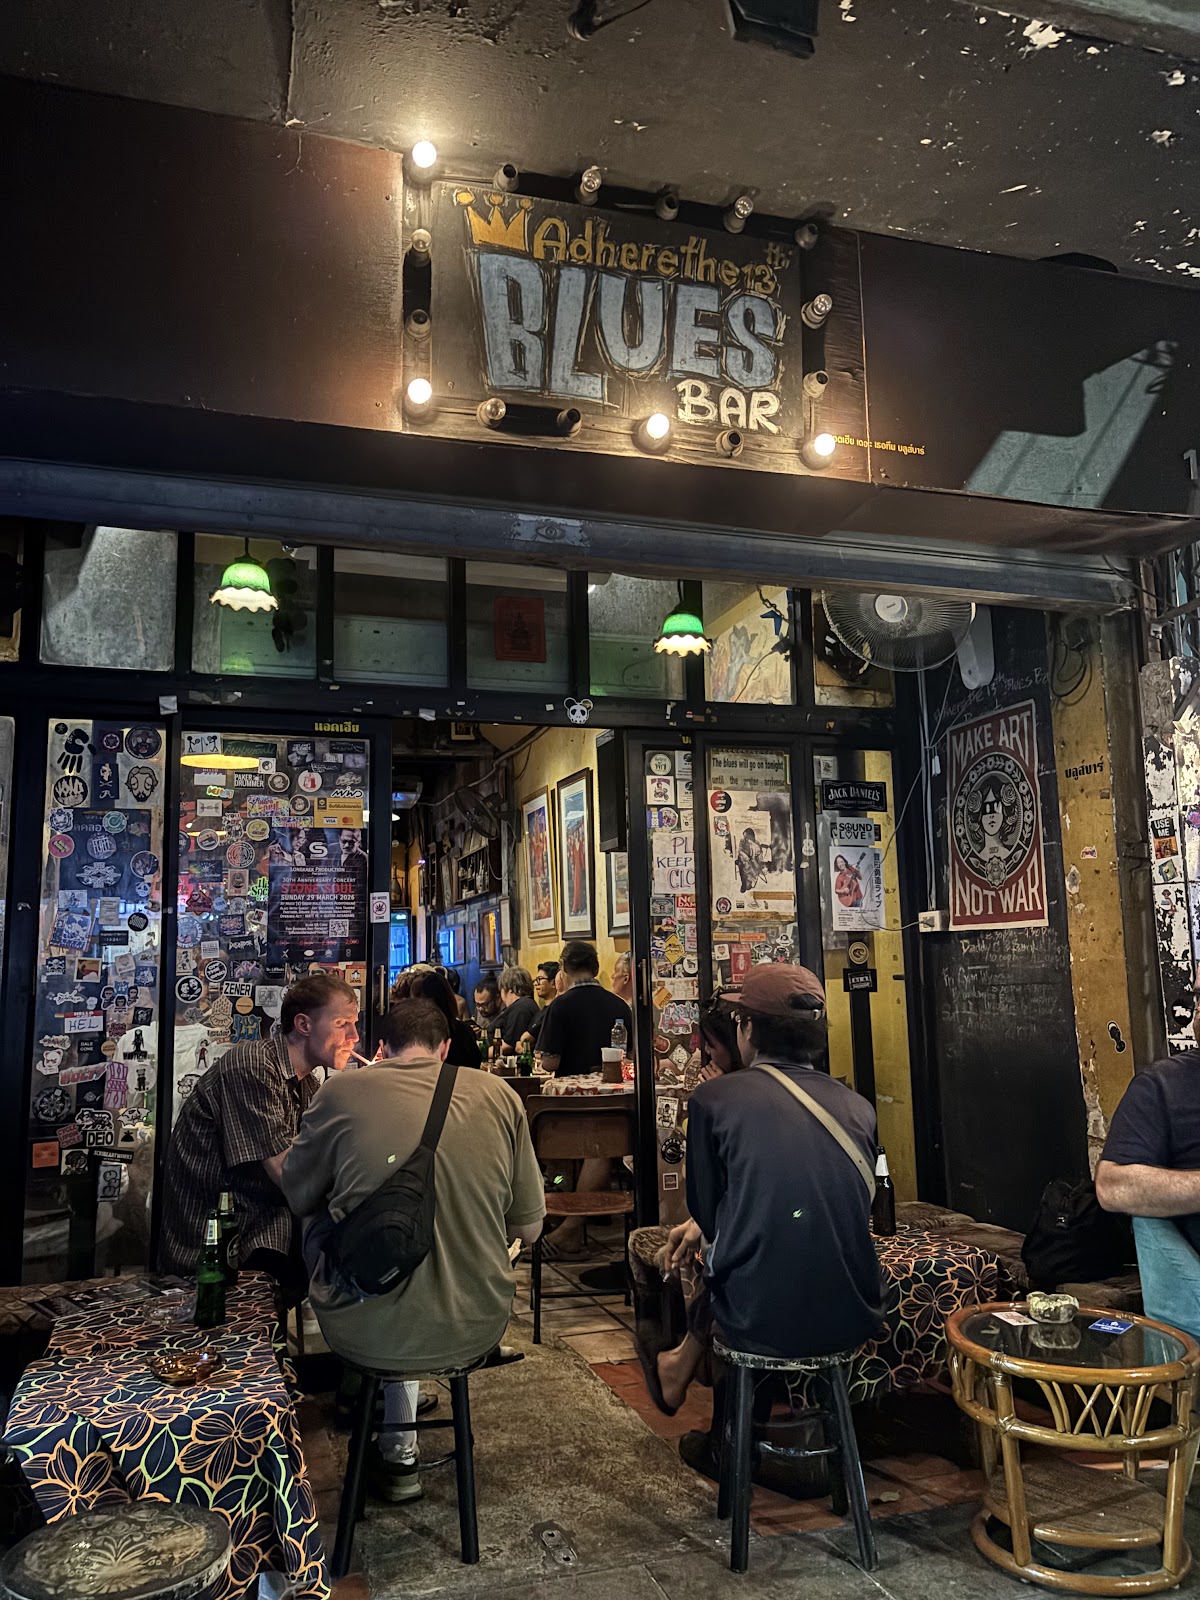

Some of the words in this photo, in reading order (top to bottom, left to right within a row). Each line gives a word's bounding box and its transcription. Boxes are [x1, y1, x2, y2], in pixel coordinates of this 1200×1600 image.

[479, 252, 781, 399] BLUES
[676, 379, 782, 433] BAR
[951, 723, 993, 790] MAKE
[998, 711, 1031, 768] ART
[712, 758, 722, 768] The
[723, 758, 738, 769] blues
[738, 759, 749, 769] will
[749, 762, 756, 771] go
[1064, 755, 1104, 781] บลูส์บาร์
[712, 775, 724, 785] until
[729, 776, 739, 785] the
[828, 787, 849, 801] JACK
[849, 786, 881, 802] DANIEL'S
[838, 822, 873, 832] SOUND
[1153, 819, 1170, 829] USE
[1157, 828, 1170, 838] ME
[656, 856, 693, 869] KEEP
[281, 883, 319, 894] STONE
[323, 883, 355, 894] SOUL
[954, 859, 996, 917] NOT
[998, 847, 1042, 914] WAR
[223, 982, 252, 996] ZENER
[69, 1018, 99, 1031] HEL
